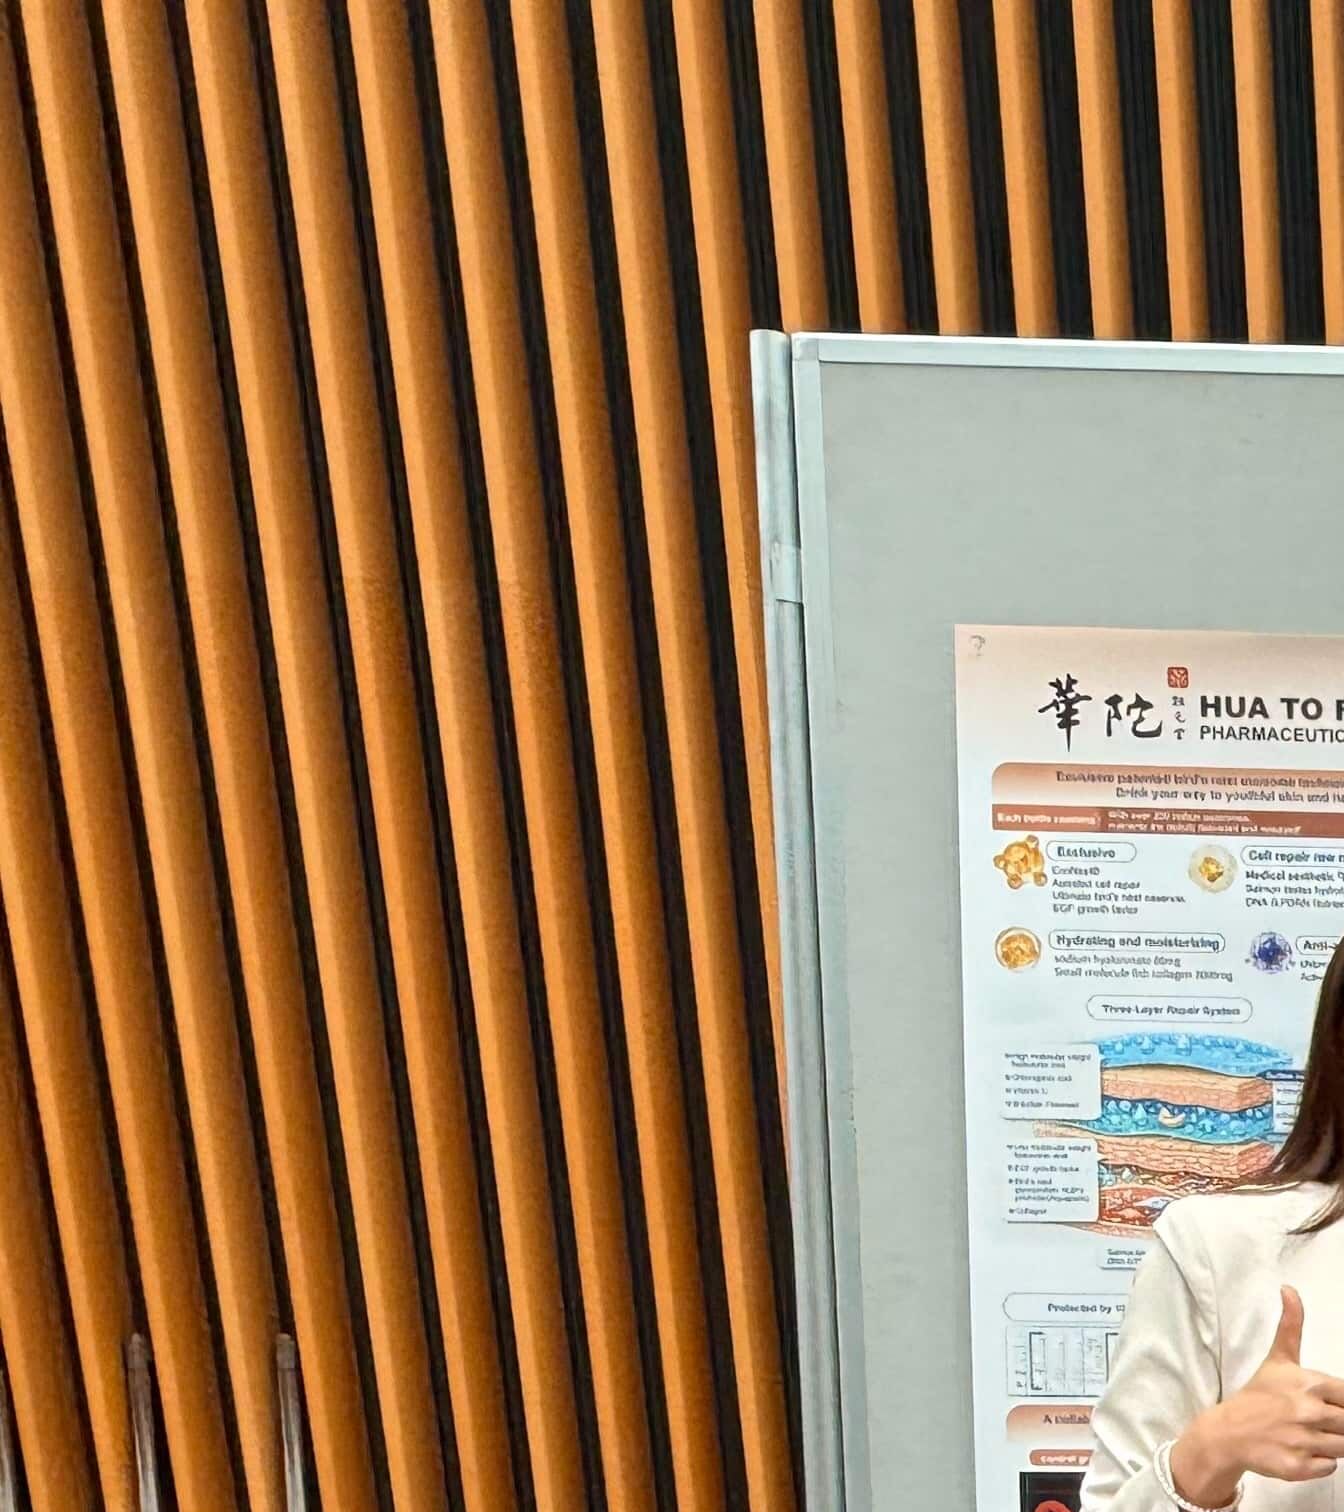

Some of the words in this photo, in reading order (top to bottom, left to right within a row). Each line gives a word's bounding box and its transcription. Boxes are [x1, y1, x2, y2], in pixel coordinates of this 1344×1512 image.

[1200, 695, 1269, 719] HUA
[1280, 697, 1323, 720] TO
[1119, 936, 1140, 946] and
